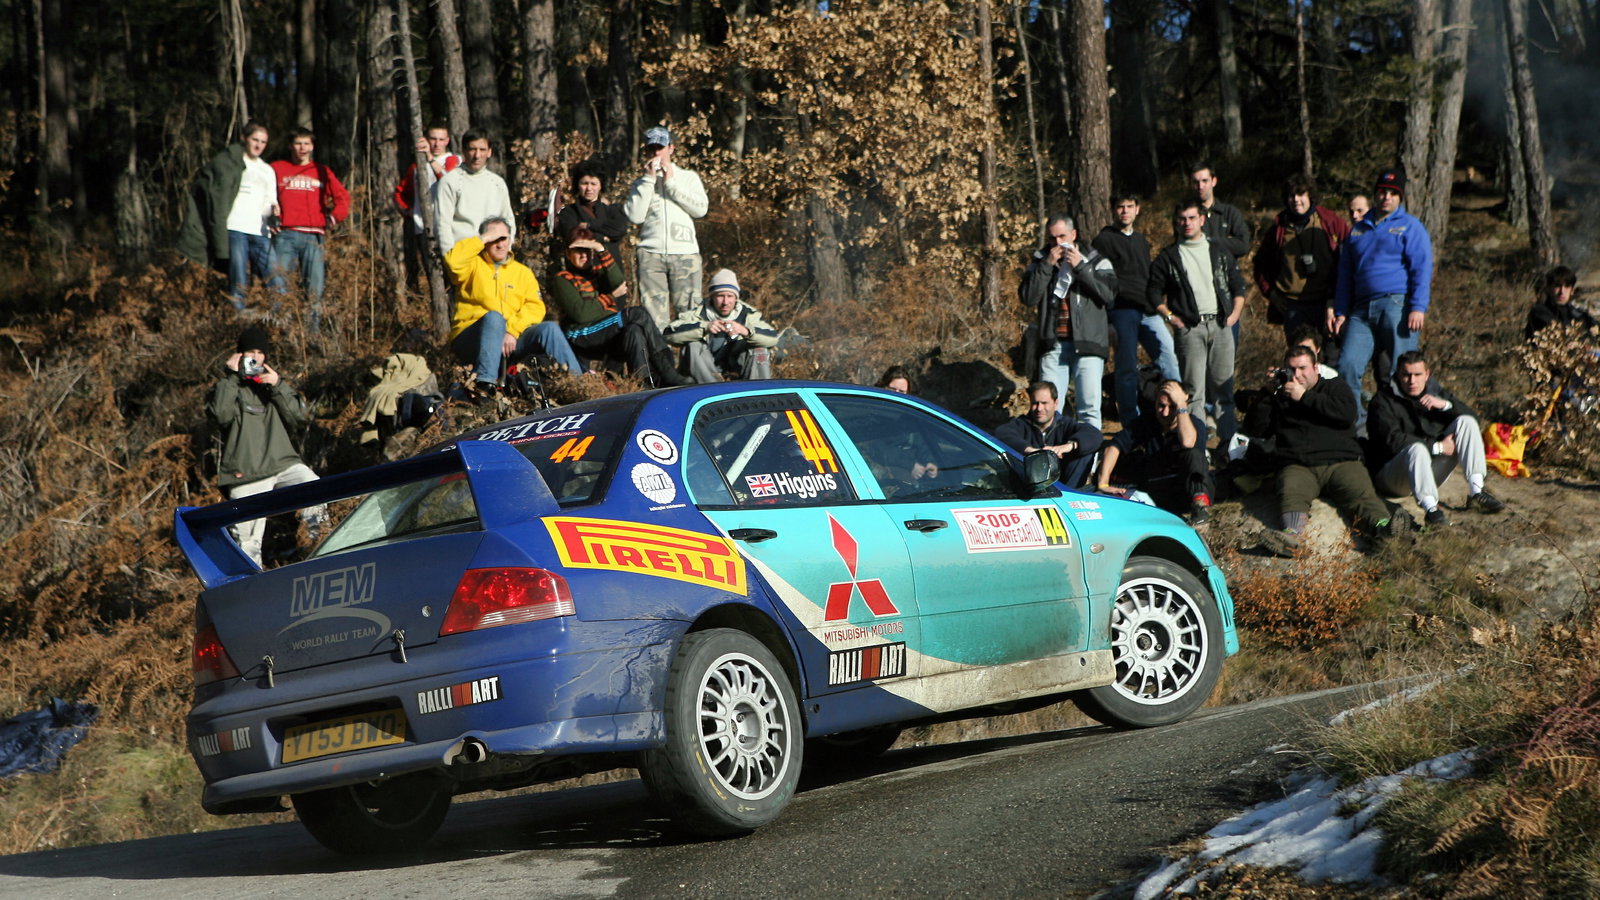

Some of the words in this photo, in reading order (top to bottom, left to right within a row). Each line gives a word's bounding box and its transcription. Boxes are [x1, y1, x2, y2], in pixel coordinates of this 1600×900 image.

[674, 225, 691, 241] 26
[549, 435, 596, 464] 44
[784, 408, 839, 474] 44
[640, 473, 673, 493] AML
[774, 469, 838, 499] Higgins
[962, 519, 994, 546] RALLYE
[975, 513, 1021, 528] 2006
[1037, 508, 1069, 545] 44
[554, 520, 737, 587] PIRELLI
[289, 562, 377, 618] MEM
[291, 636, 323, 651] WORLD
[324, 631, 349, 645] RALLY
[352, 626, 377, 640] TEAM
[824, 626, 869, 644] MITSUBISHI
[871, 621, 904, 637] MOTORS
[291, 722, 347, 756] YT53
[351, 713, 397, 745] BWO
